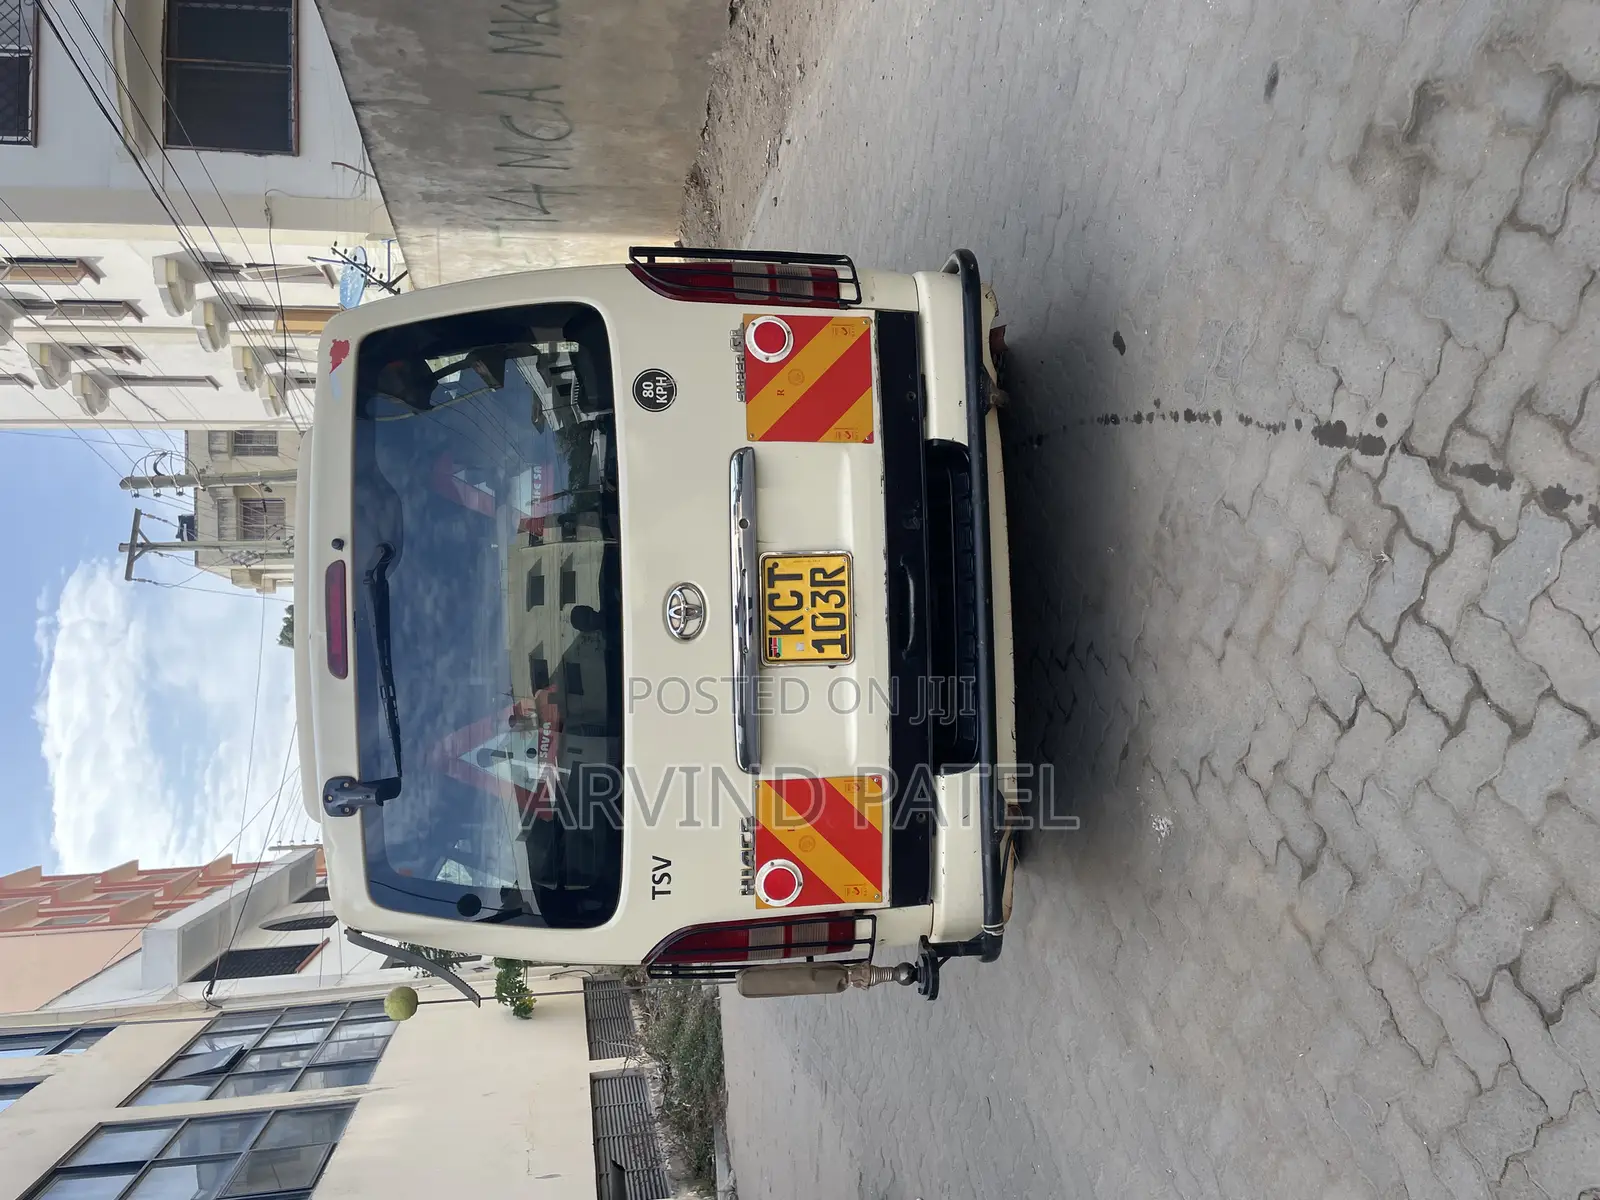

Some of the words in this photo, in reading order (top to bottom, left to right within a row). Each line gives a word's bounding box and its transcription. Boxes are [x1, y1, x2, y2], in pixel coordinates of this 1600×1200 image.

[729, 322, 744, 353] GL
[642, 381, 654, 398] 80
[655, 376, 668, 403] KPH
[734, 354, 746, 402] SUPER
[776, 388, 785, 396] R
[767, 566, 804, 636] KCT
[809, 565, 847, 655] 103R
[651, 855, 671, 901] TSV
[738, 816, 755, 896] HIACE
